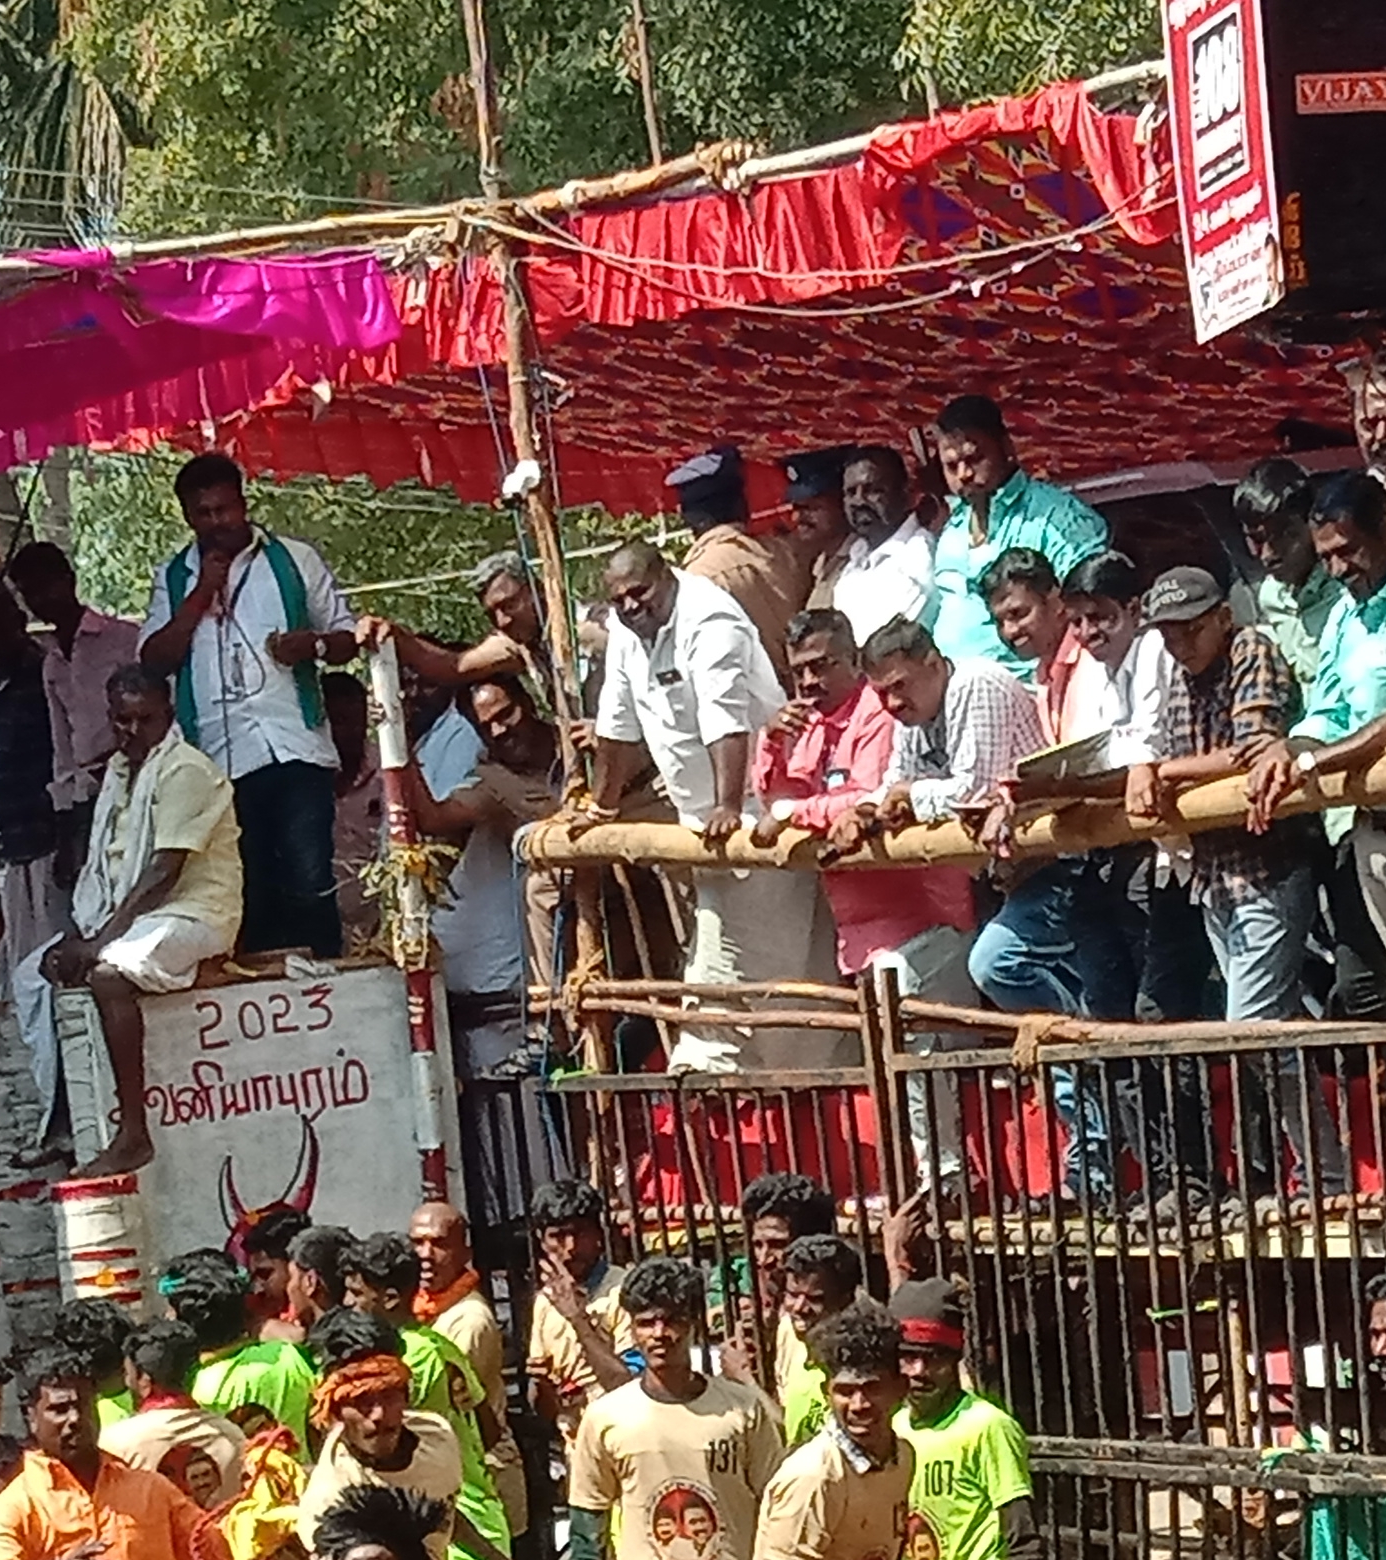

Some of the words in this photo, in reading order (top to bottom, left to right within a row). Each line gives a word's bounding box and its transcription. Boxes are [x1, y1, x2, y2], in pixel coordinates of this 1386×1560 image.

[196, 983, 334, 1050] 2023
[109, 1047, 370, 1128] வனியாபுரம்
[708, 1439, 738, 1475] 131
[924, 1460, 954, 1497] 107
